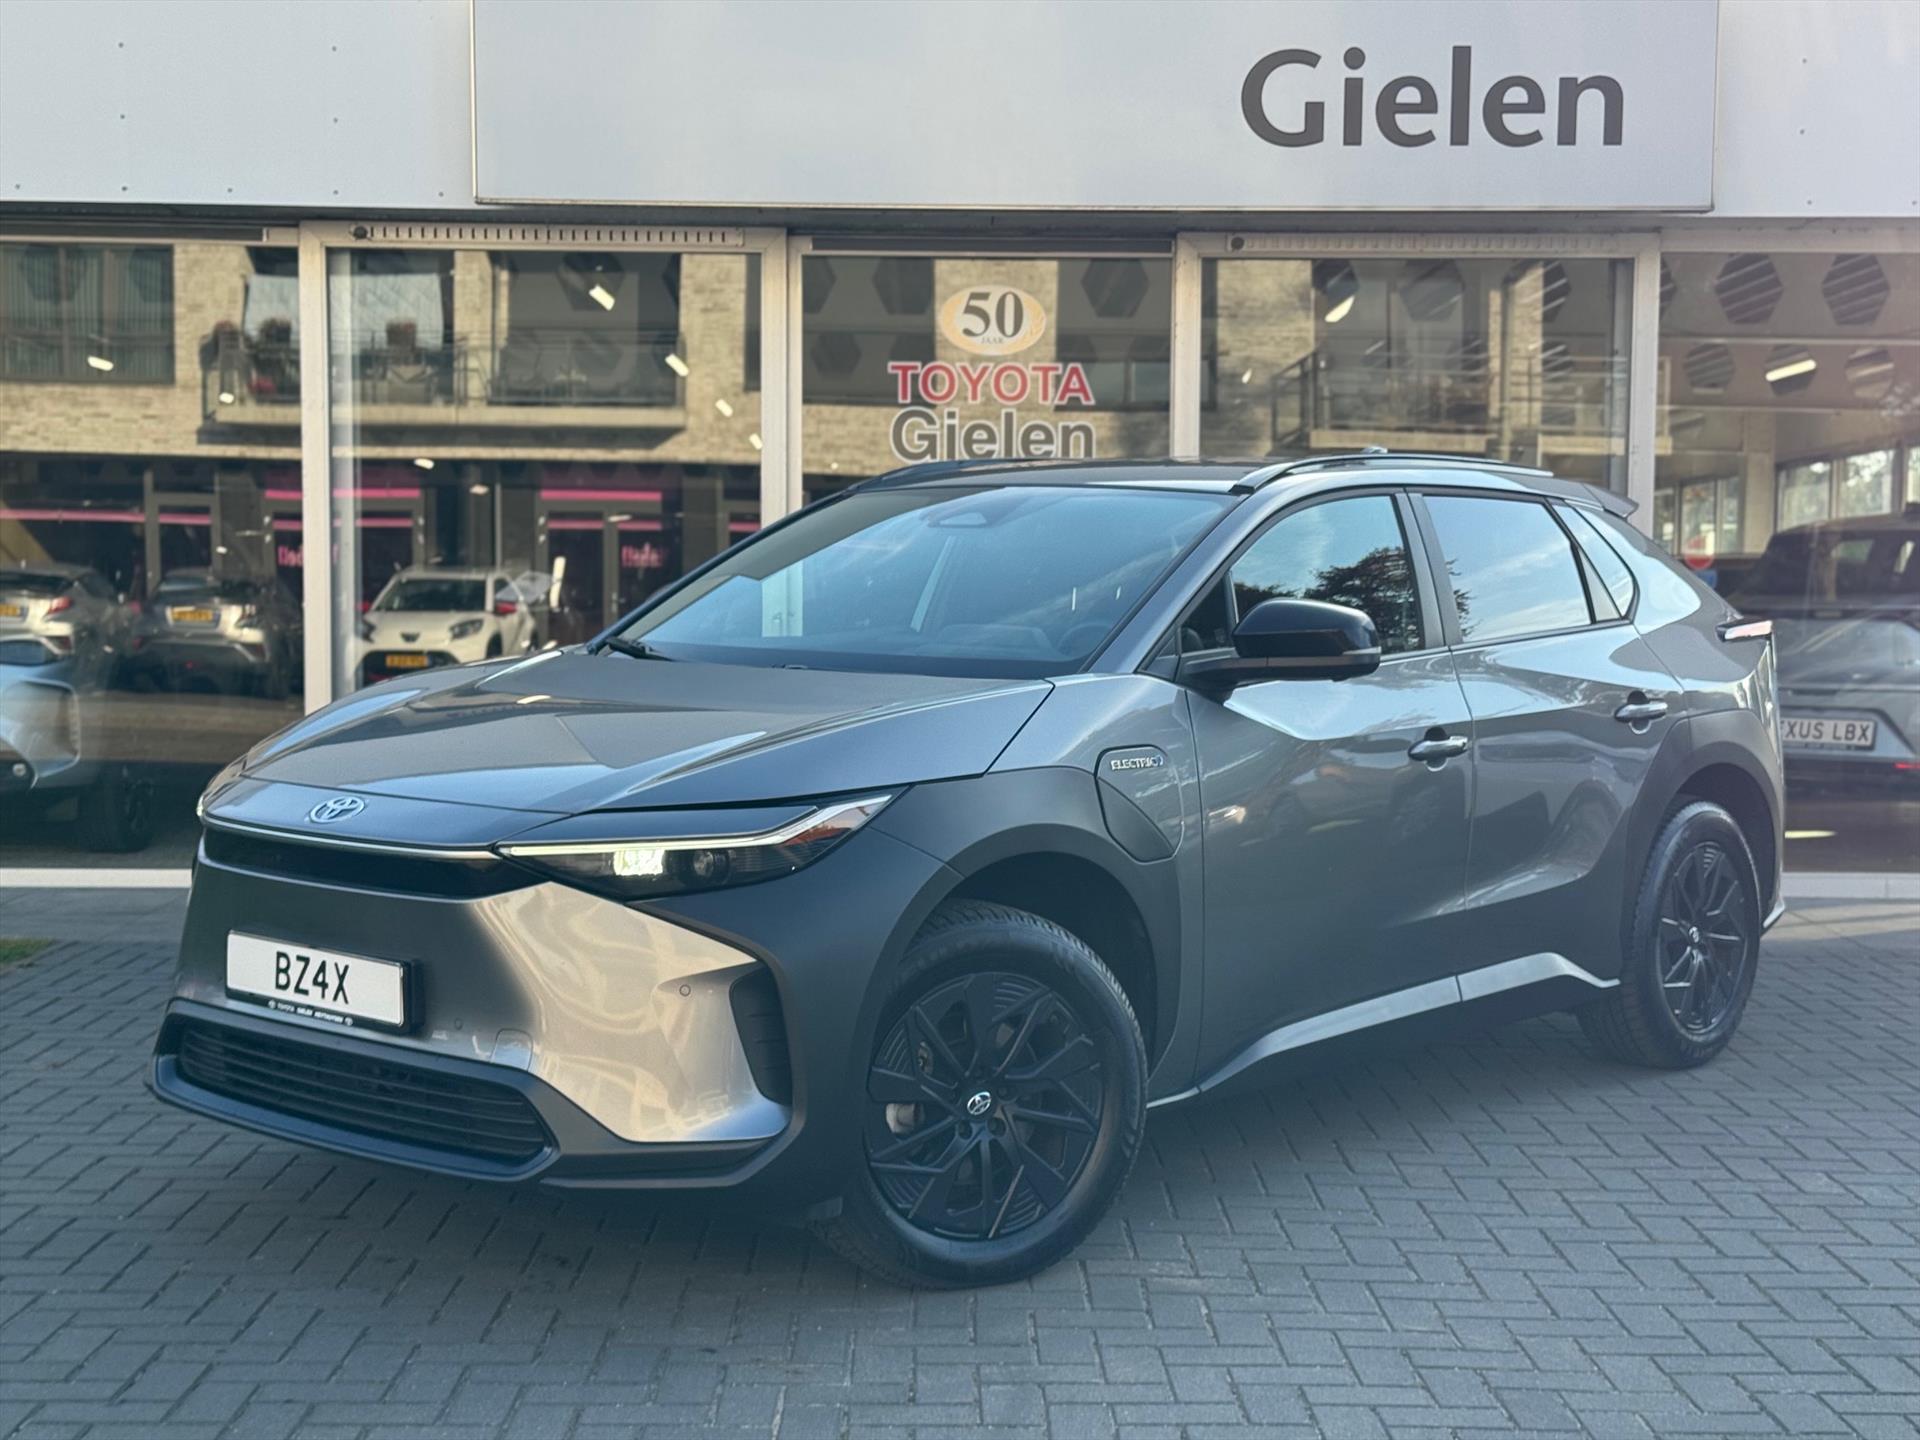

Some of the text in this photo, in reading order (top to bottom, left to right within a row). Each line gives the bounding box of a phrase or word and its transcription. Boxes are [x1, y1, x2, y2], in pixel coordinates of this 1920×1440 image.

[1241, 45, 1624, 148] Gielen
[962, 291, 1024, 338] 50
[888, 361, 1095, 405] TOYOTA
[890, 406, 1097, 464] Gielen
[1832, 722, 1870, 743] LBX
[275, 951, 350, 1005] BZ4X
